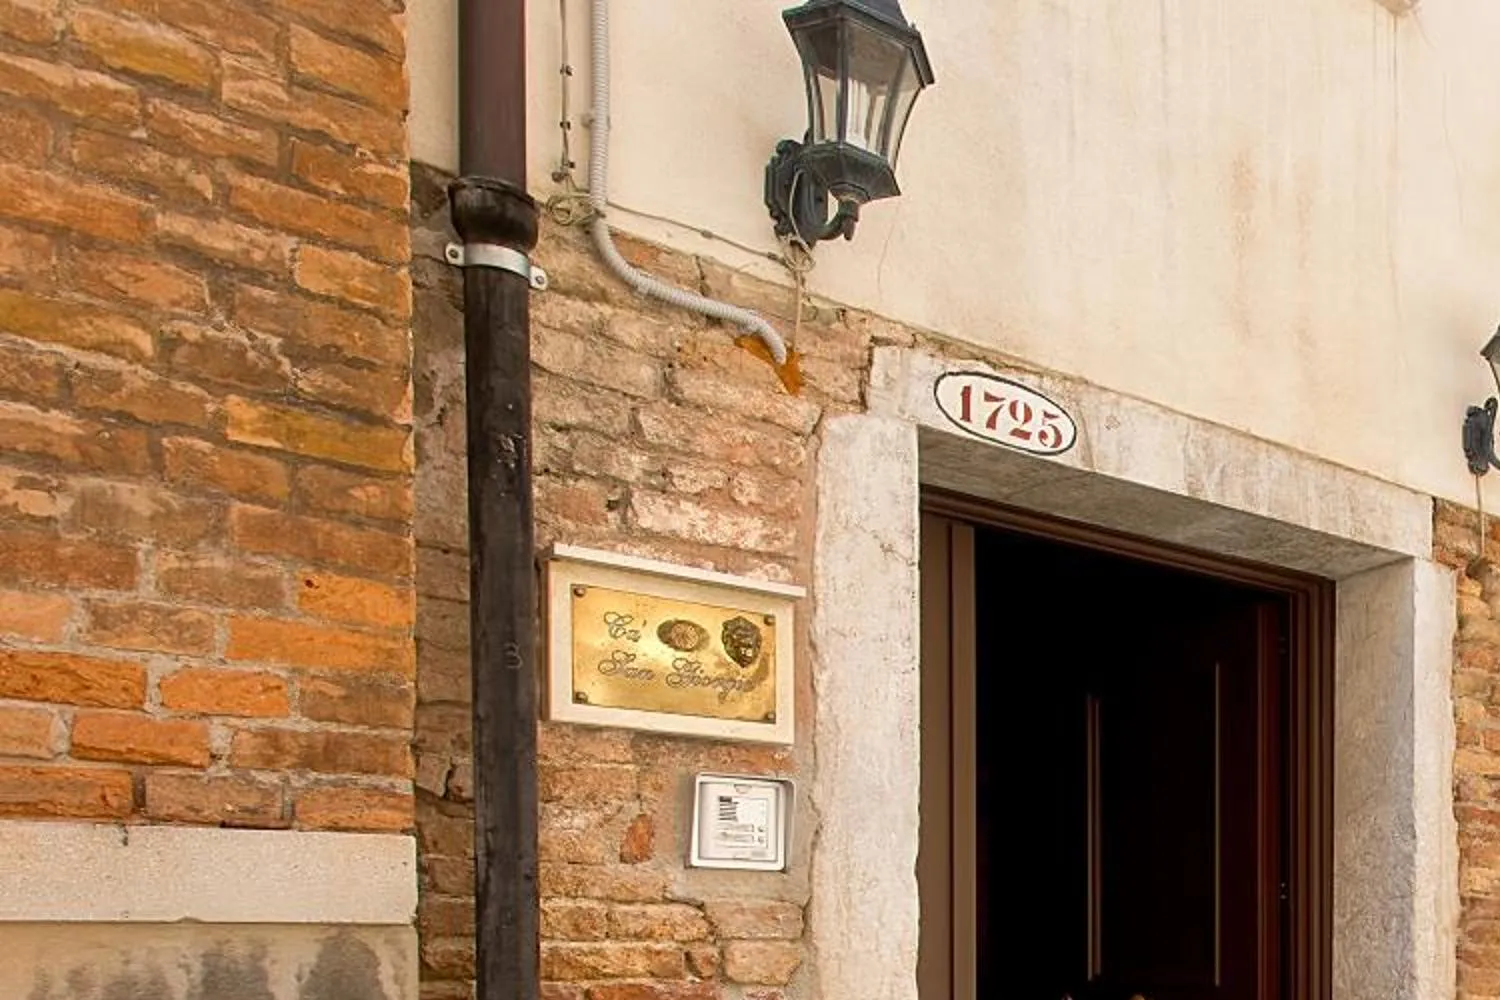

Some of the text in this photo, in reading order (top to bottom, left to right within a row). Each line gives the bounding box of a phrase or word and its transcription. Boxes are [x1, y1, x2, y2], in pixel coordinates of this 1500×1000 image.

[960, 384, 1063, 449] 1725
[598, 650, 758, 704] San Giorgio
